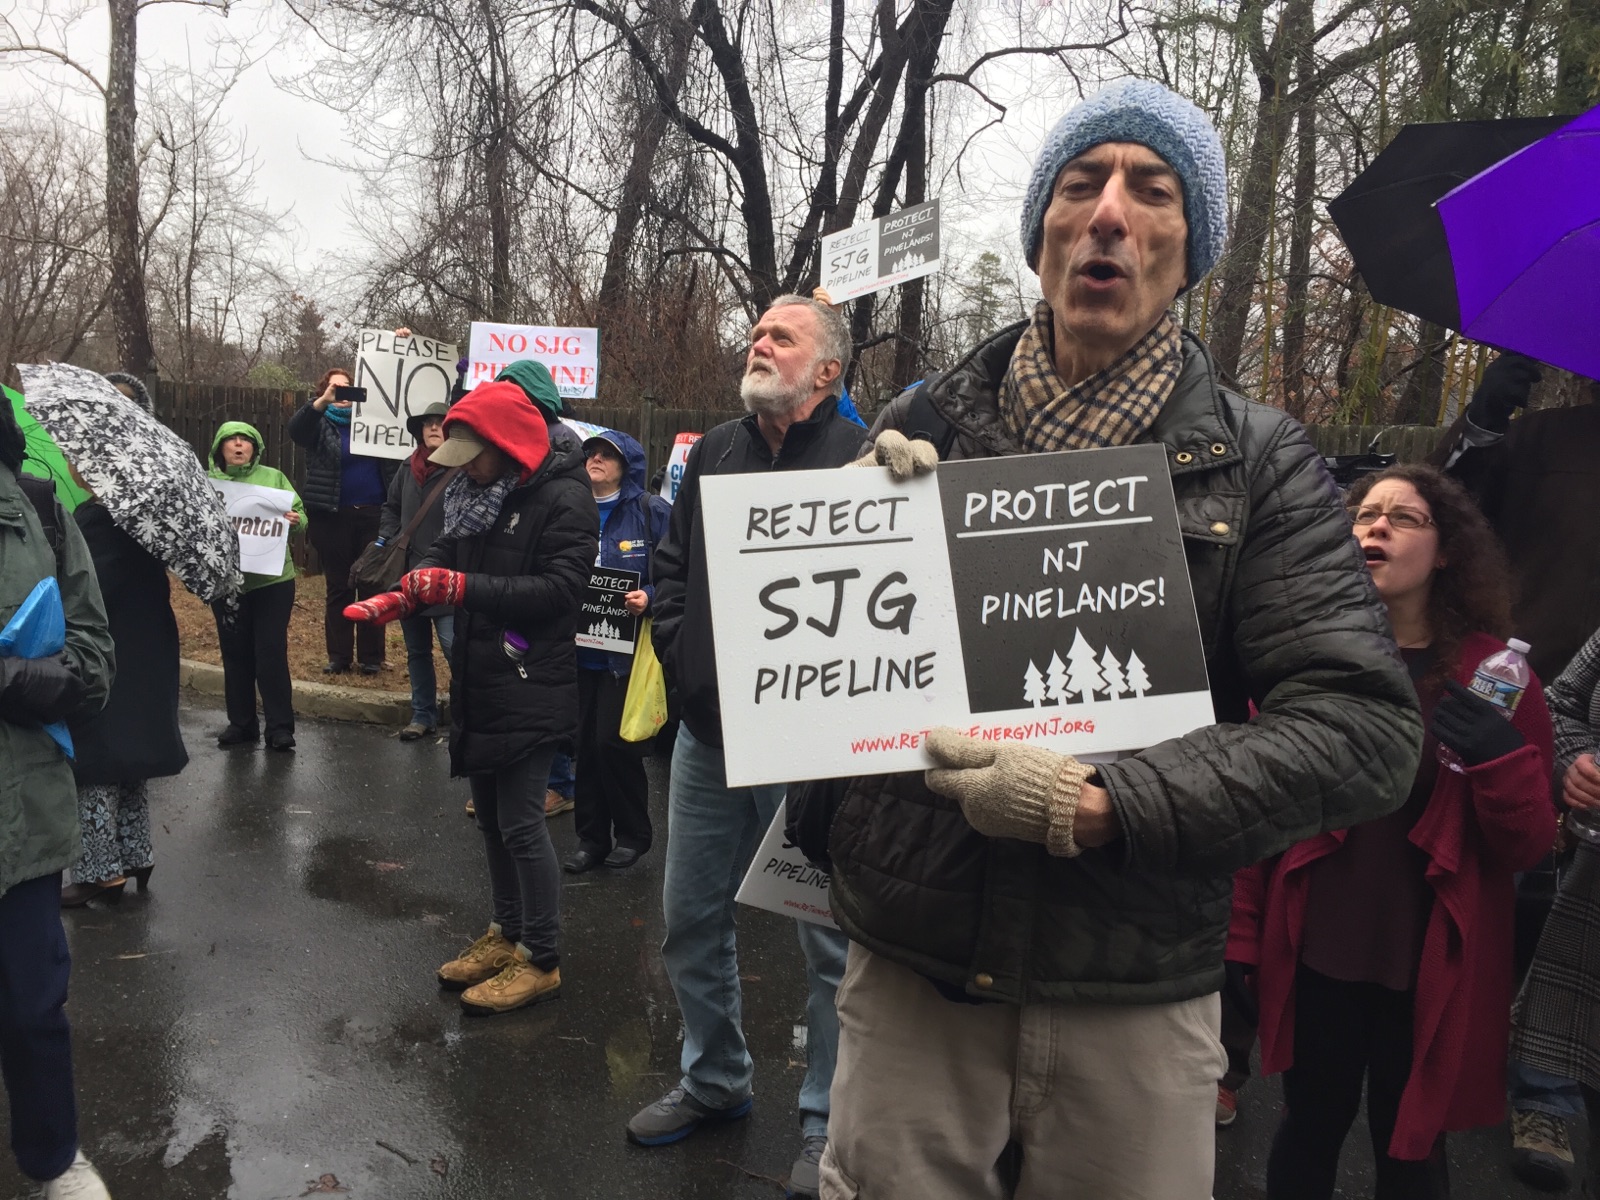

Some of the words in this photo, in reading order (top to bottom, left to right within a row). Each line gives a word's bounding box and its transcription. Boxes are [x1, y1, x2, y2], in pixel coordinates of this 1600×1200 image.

[883, 207, 934, 232] PROTECT
[829, 228, 871, 251] REJECT
[883, 232, 934, 256] PINELANDS!
[902, 227, 916, 240] NJ
[830, 248, 870, 274] SJG
[826, 265, 872, 289] PIPELINE
[362, 332, 452, 362] PLEASE
[488, 333, 527, 354] NO
[534, 335, 581, 356] SJG
[355, 356, 451, 419] NO
[352, 421, 415, 448] PIPELI
[964, 475, 1149, 528] PROTECT
[746, 496, 910, 542] REJECT
[1042, 541, 1089, 575] NJ
[590, 574, 634, 590] ROTECT
[581, 603, 630, 618] PINELANDS!
[600, 594, 614, 603] NJ
[758, 568, 918, 640] SJG
[981, 576, 1166, 625] PINELANDS!
[754, 651, 936, 704] PIPELINE
[763, 858, 831, 889] PIPELINE
